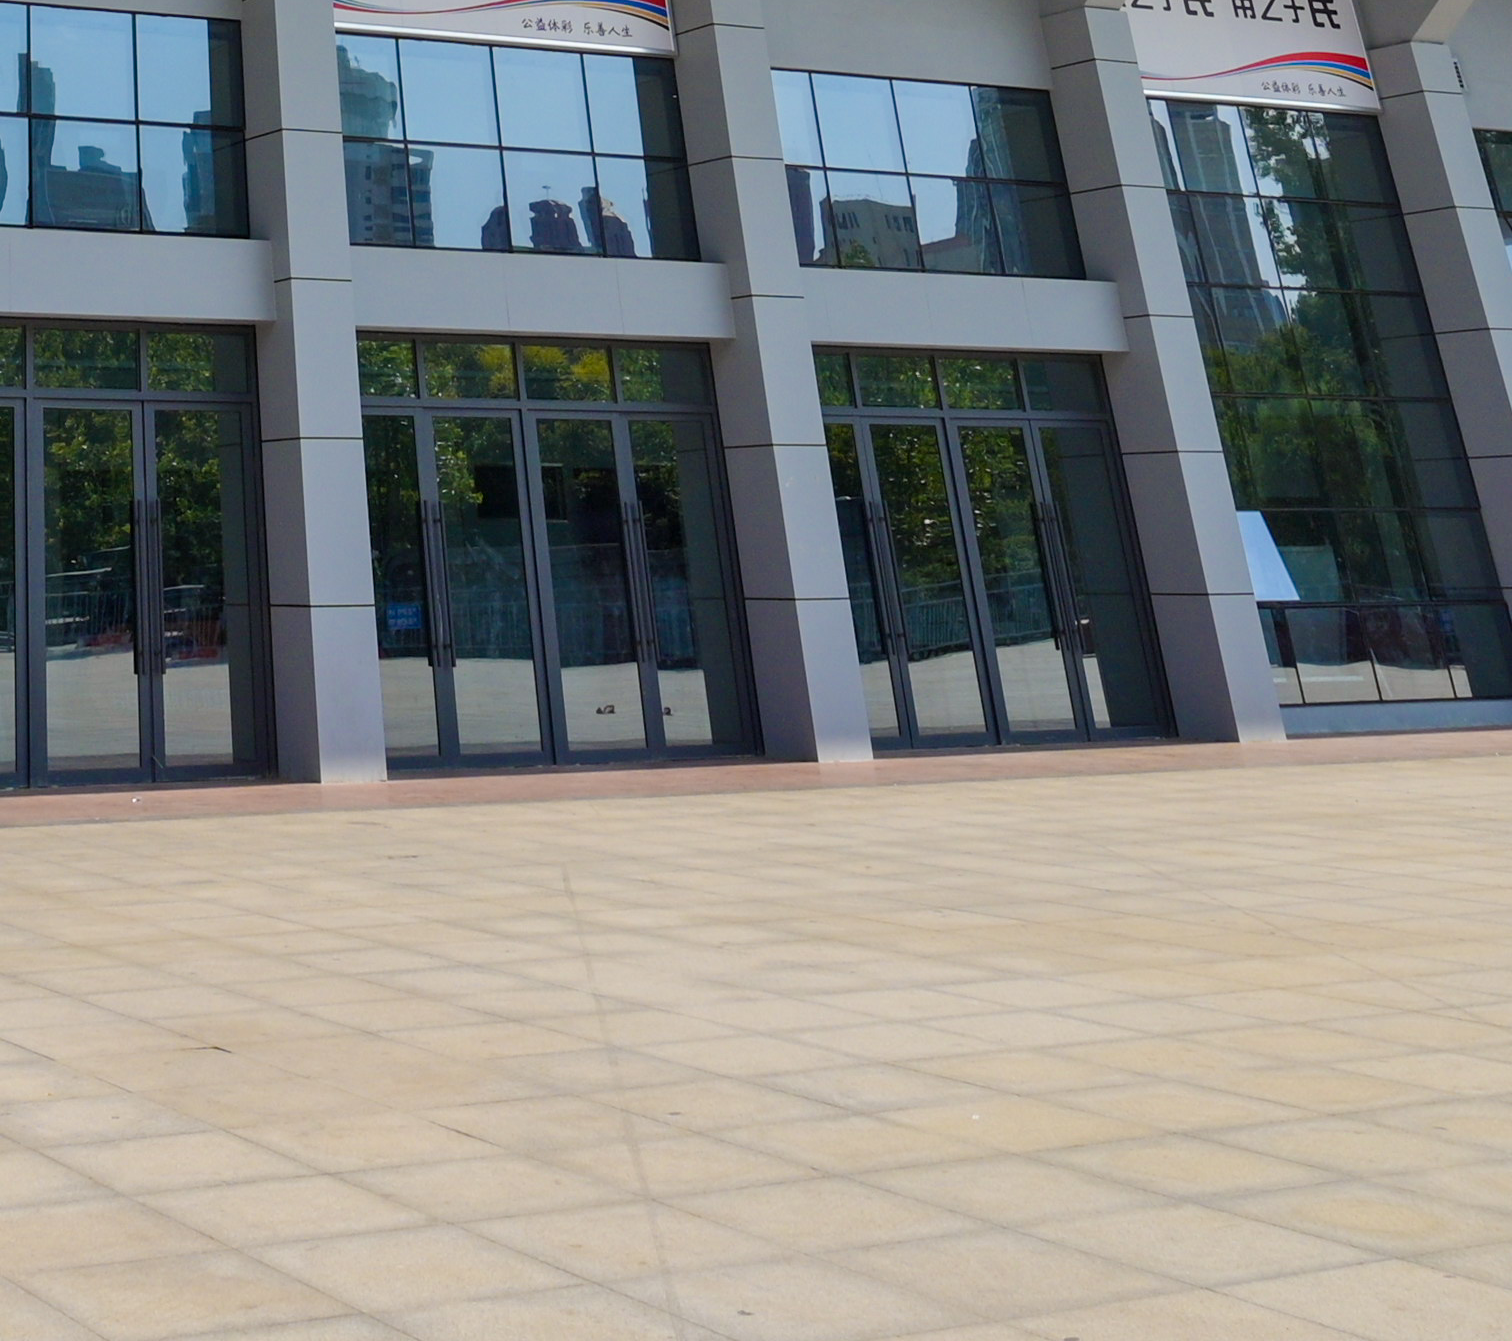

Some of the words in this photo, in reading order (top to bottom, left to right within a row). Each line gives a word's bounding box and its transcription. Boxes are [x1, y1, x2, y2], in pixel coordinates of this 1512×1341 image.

[521, 17, 573, 34] 公益体彩
[583, 21, 633, 38] 乐善人生
